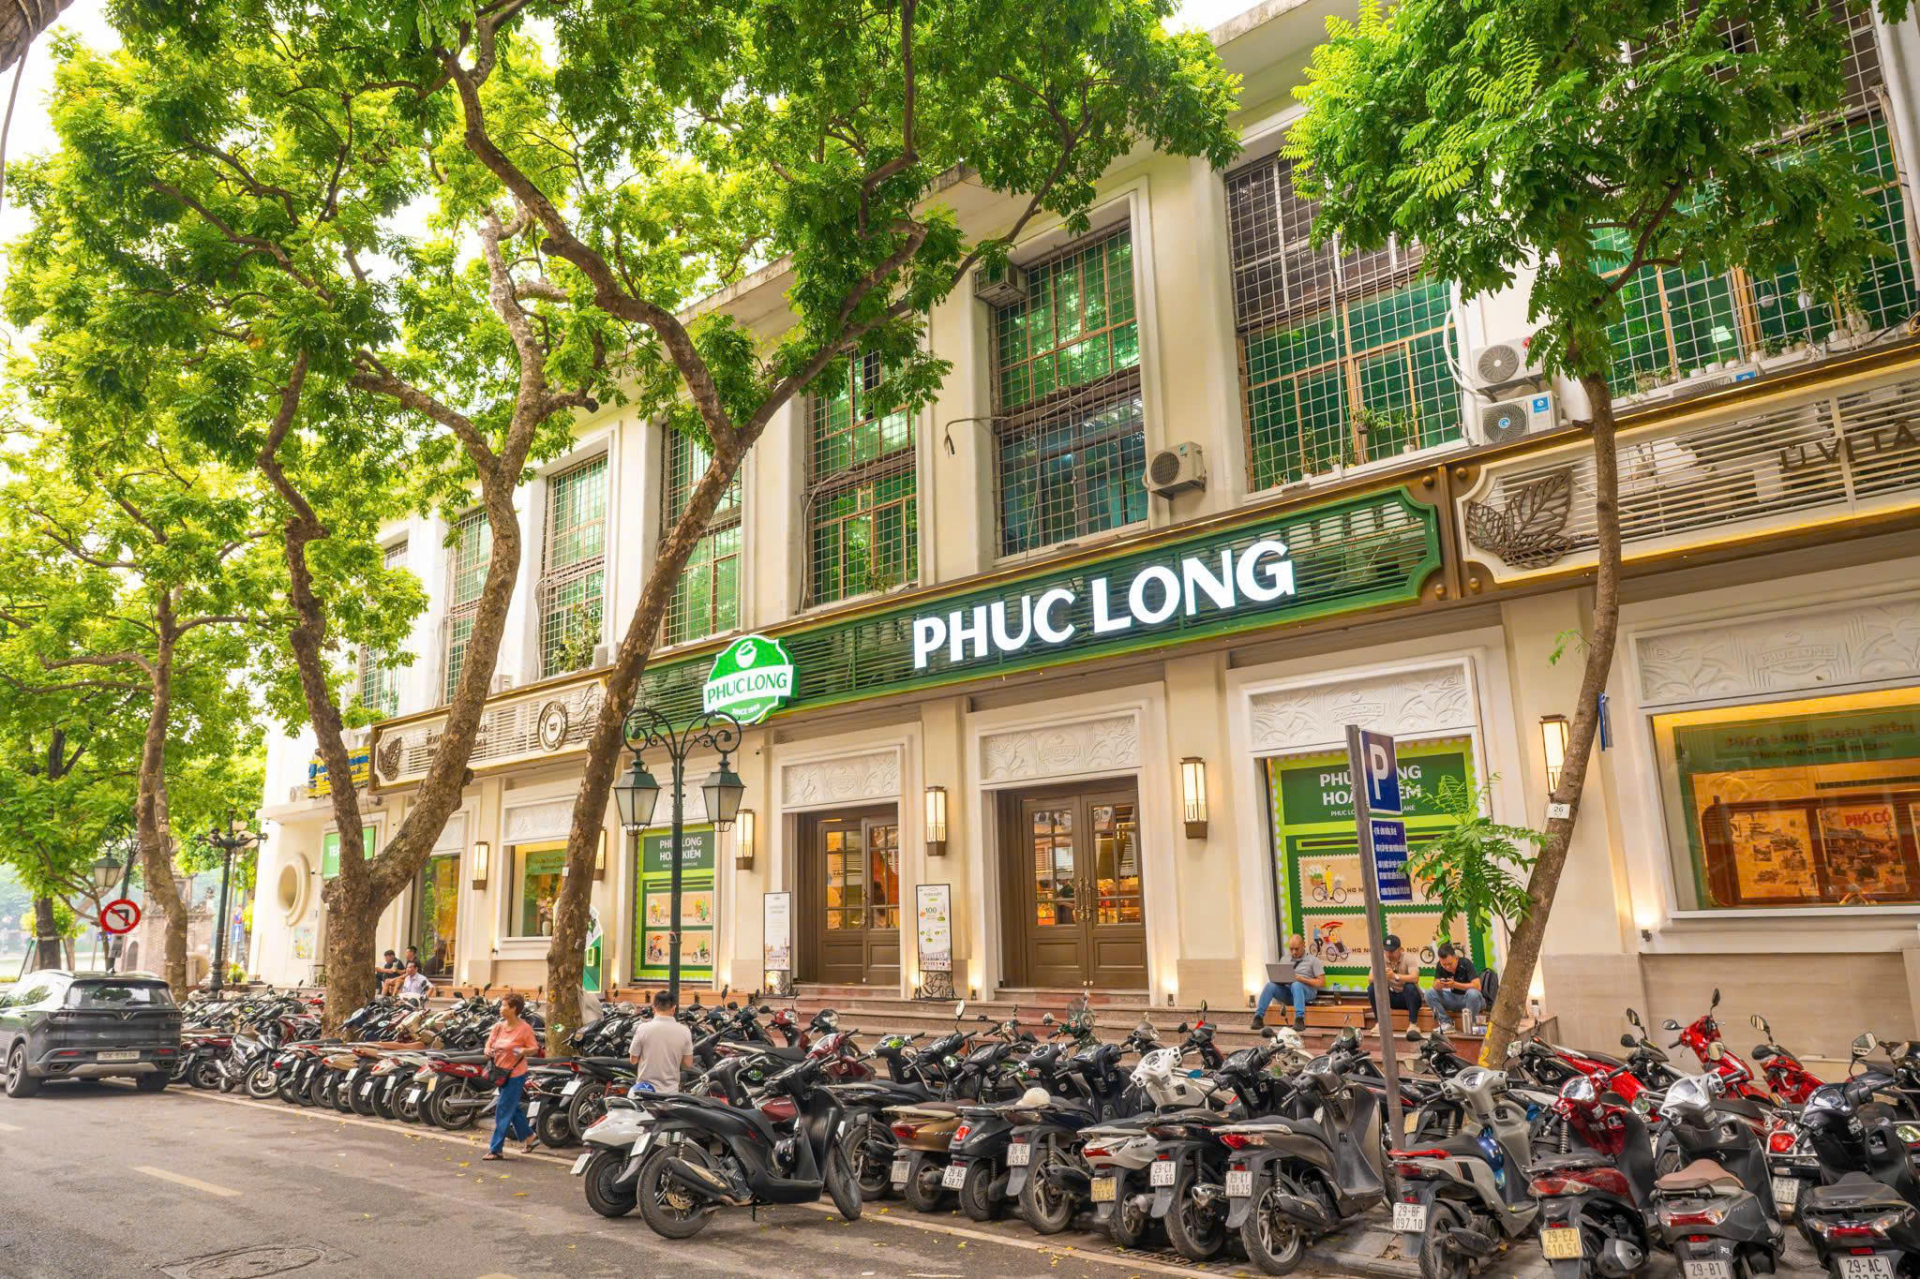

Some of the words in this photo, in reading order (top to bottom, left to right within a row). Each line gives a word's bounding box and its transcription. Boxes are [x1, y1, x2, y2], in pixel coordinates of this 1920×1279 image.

[913, 589, 1076, 669] PHUC
[1091, 540, 1297, 634] LONG
[1320, 769, 1352, 787] PHÚ
[1397, 765, 1422, 780] NG
[1369, 743, 1389, 800] P
[1322, 787, 1355, 806] HO
[1395, 1217, 1423, 1229] 097.10
[1690, 1262, 1722, 1277] 29-B1
[1846, 1258, 1883, 1273] 29-AC
